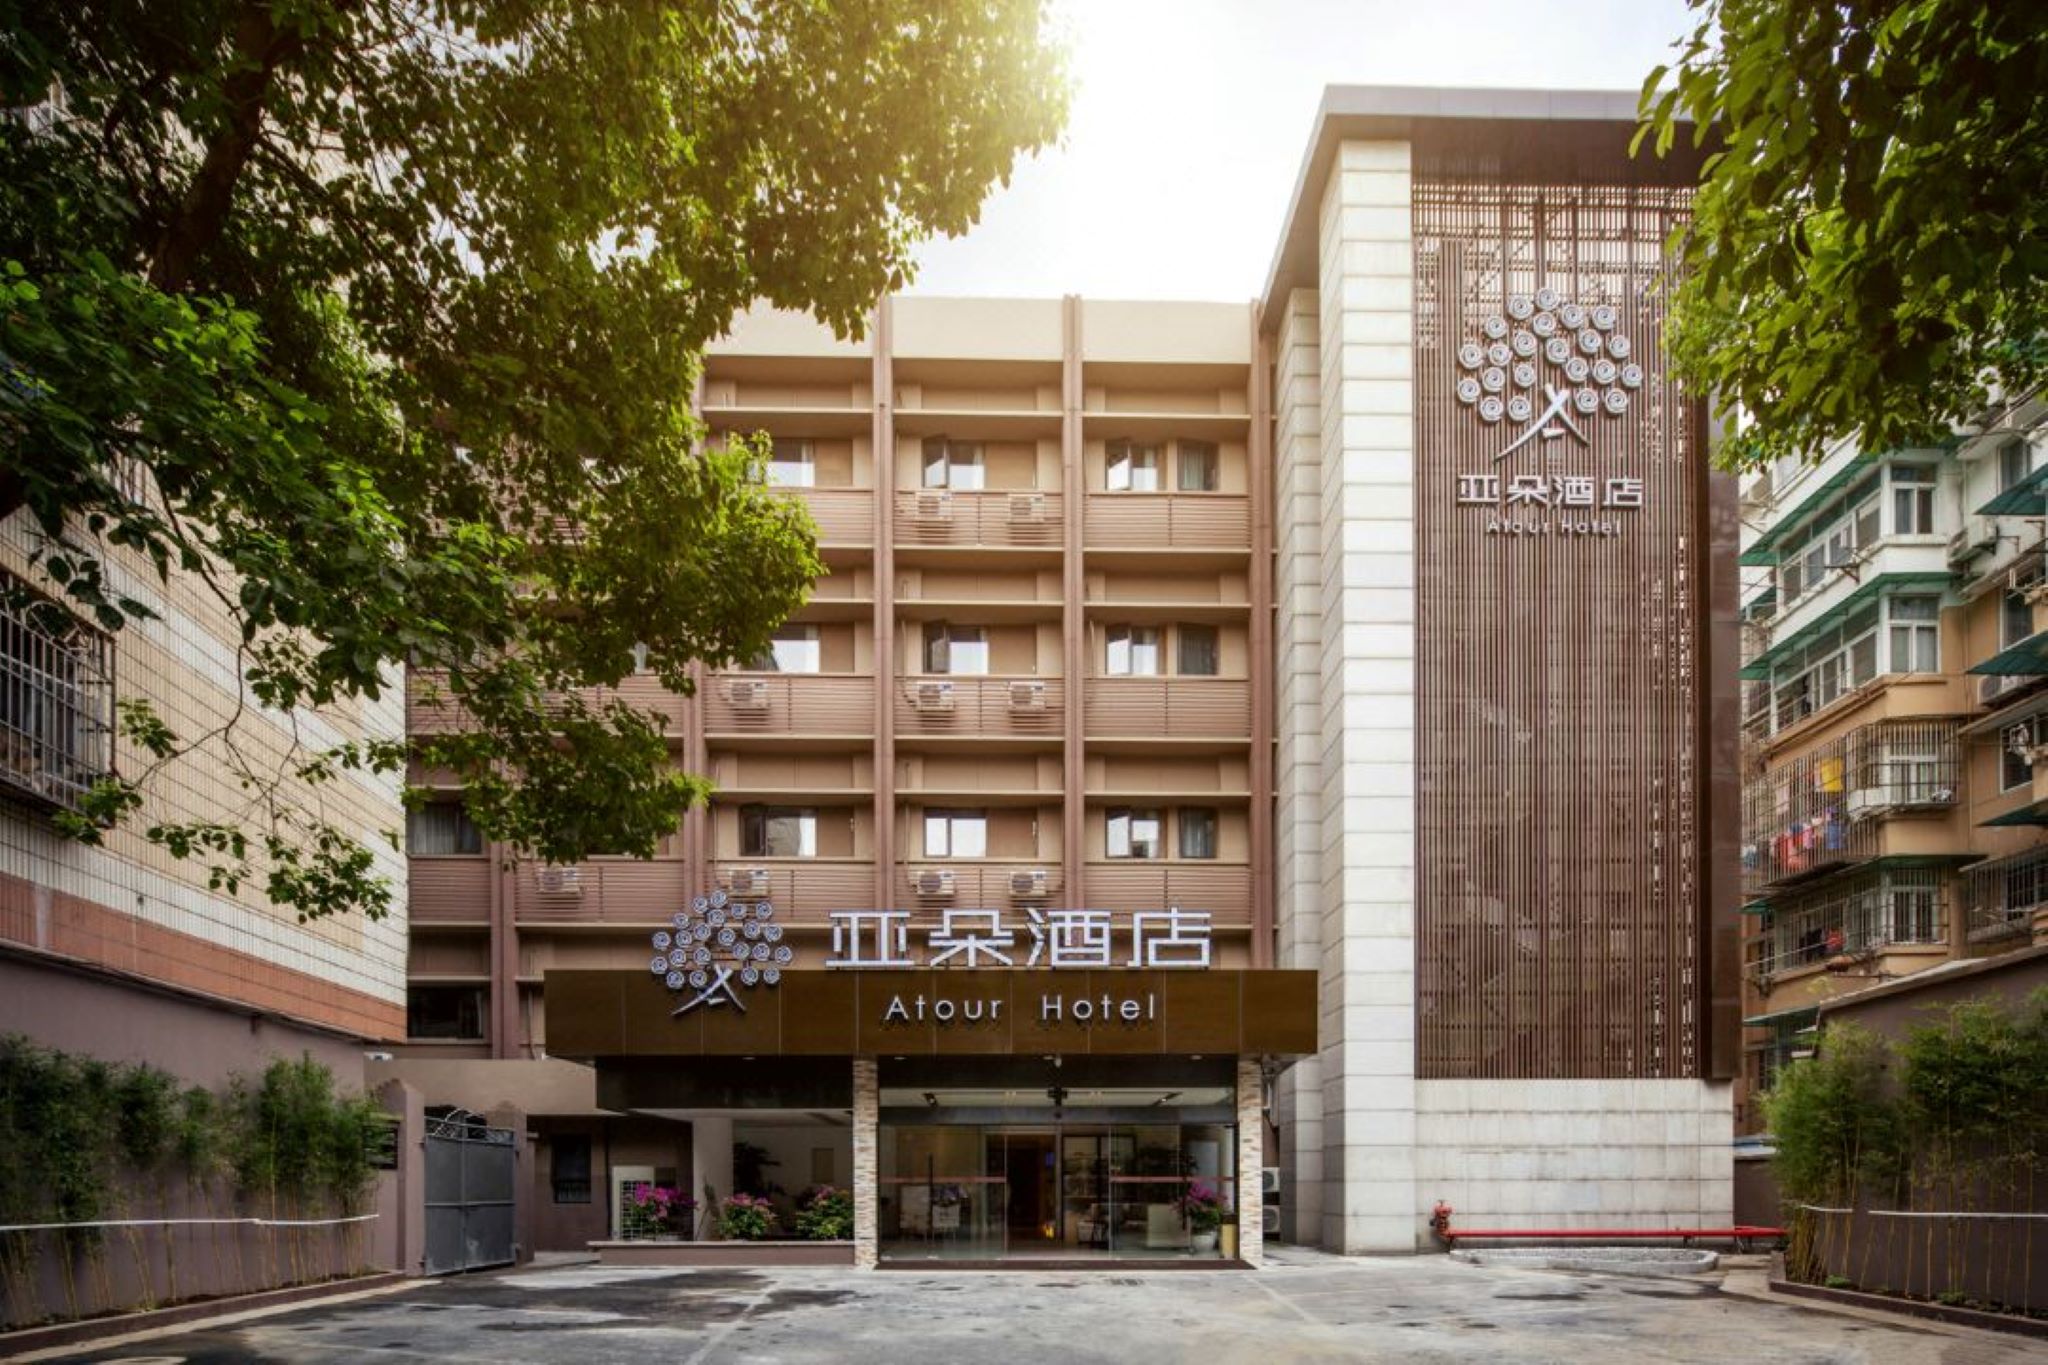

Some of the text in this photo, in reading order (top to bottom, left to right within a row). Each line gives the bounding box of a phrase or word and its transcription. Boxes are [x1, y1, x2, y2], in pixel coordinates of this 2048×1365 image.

[1457, 475, 1643, 506] 亚朵酒店
[1561, 518, 1621, 533] Hotel
[825, 906, 1214, 969] 亚朵酒店
[885, 994, 1156, 1020] Atour Hotel
